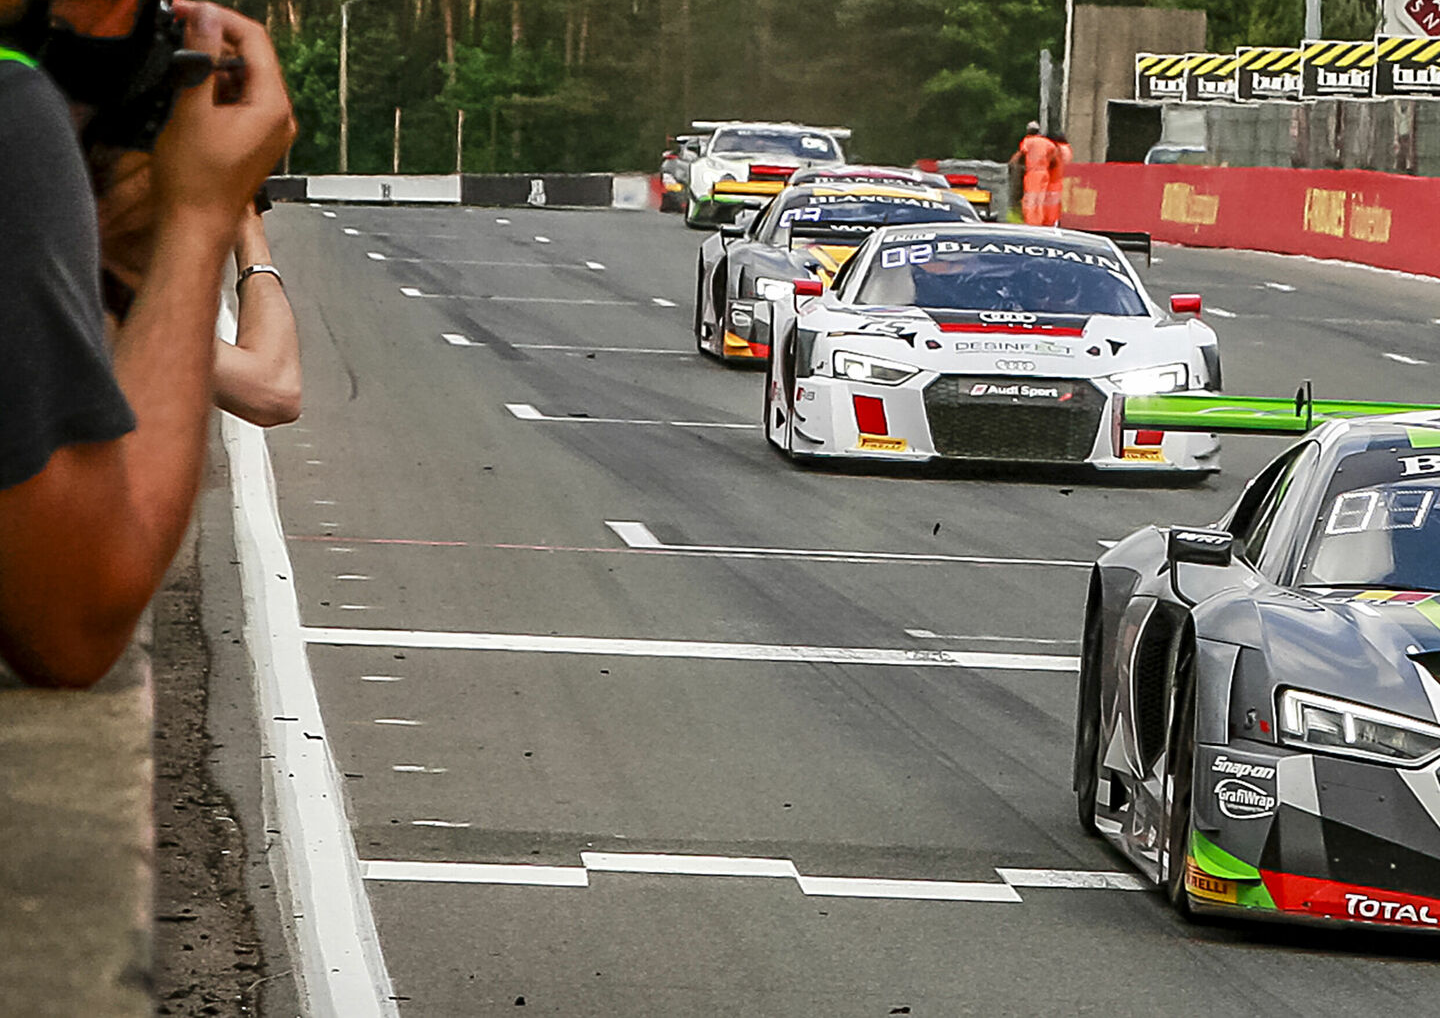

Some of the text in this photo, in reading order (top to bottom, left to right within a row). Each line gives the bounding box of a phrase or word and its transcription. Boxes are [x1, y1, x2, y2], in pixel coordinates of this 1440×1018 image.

[936, 241, 1122, 272] BLANCPAIN
[986, 385, 1058, 398] Audi Sport
[1211, 755, 1275, 780] Snap-on
[1218, 787, 1275, 811] GrafiWrap
[1345, 894, 1438, 924] TOTAL
